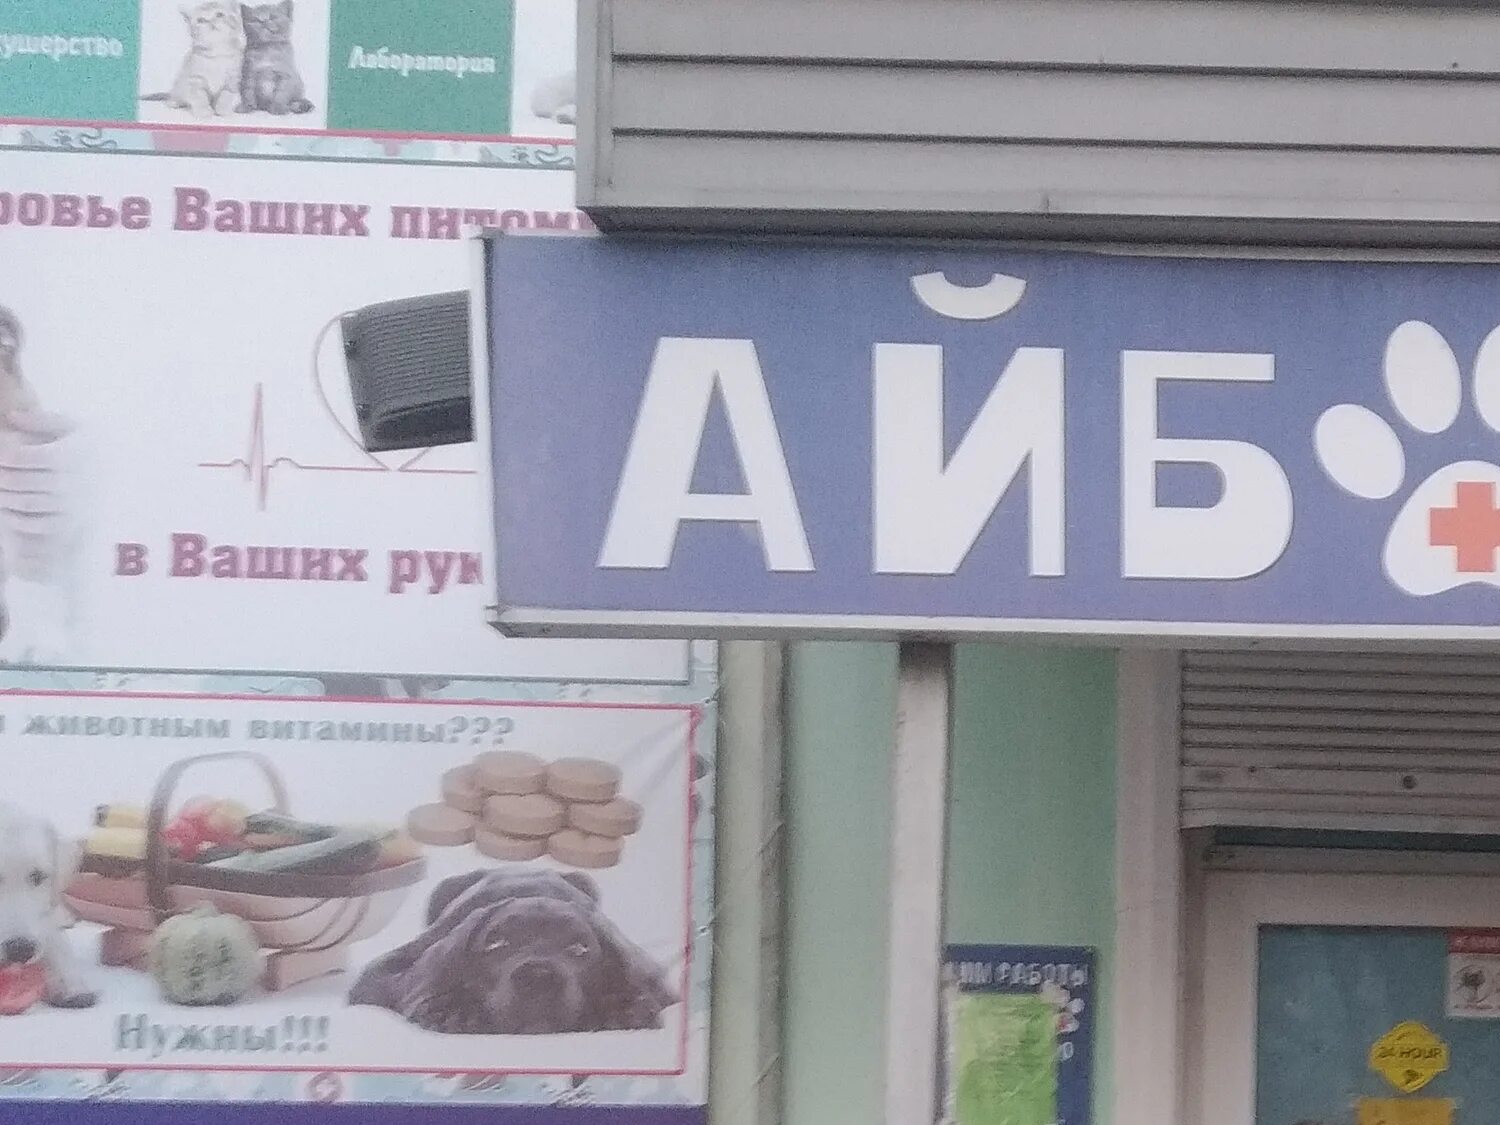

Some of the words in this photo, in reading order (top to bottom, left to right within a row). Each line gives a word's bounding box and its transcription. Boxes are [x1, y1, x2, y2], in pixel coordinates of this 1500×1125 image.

[348, 45, 496, 78] Лаборатория
[173, 186, 369, 236] Ваших
[115, 542, 149, 577] в
[171, 533, 368, 581] Ваших
[22, 714, 230, 738] животным
[248, 716, 514, 744] витамины???
[116, 1013, 329, 1058] Нужны!!!
